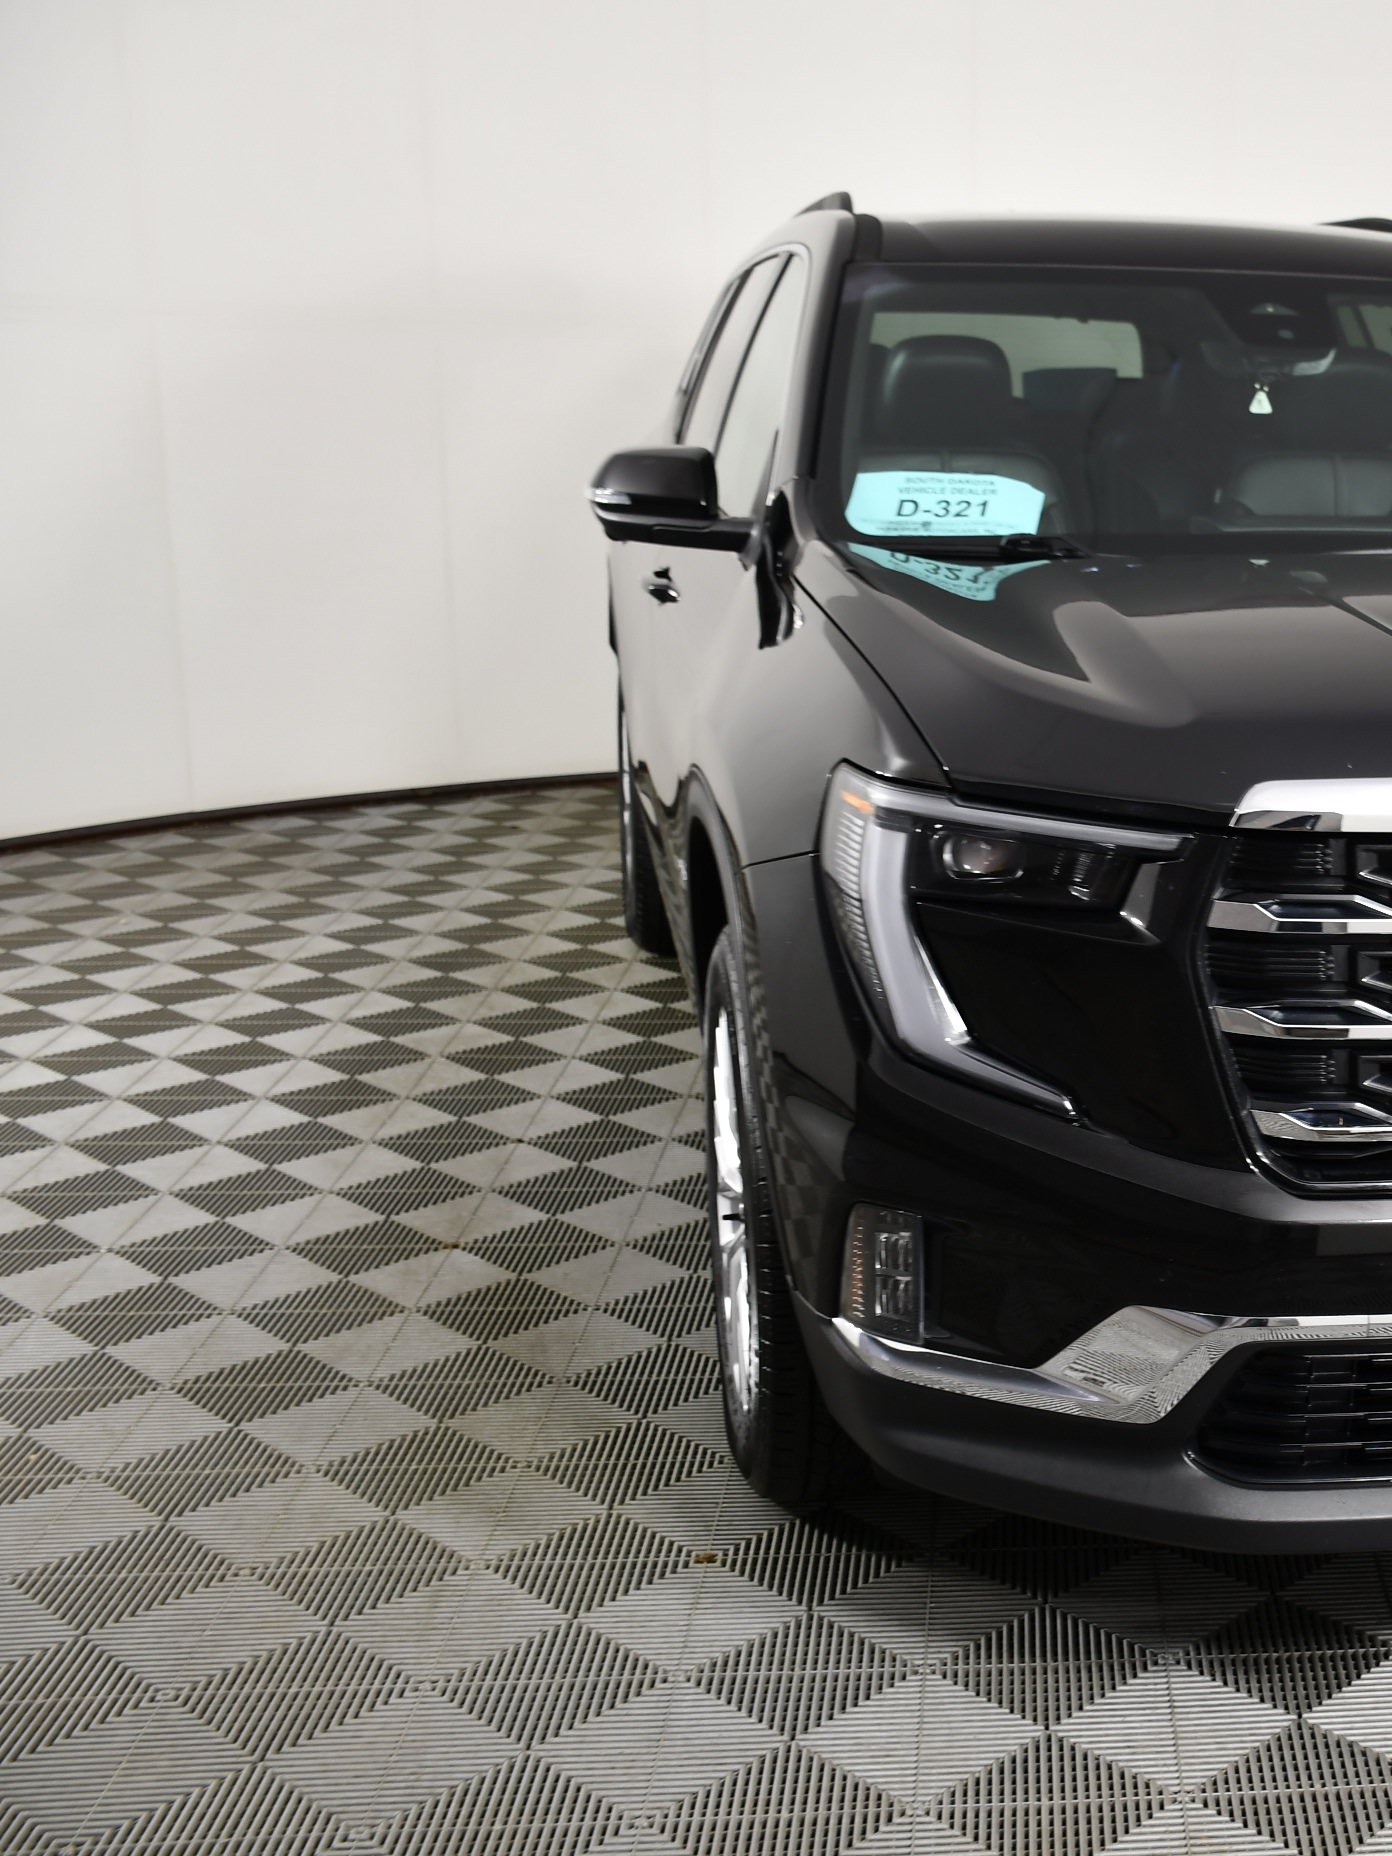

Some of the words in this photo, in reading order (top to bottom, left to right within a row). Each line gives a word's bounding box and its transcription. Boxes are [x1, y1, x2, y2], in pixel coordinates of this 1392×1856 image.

[897, 487, 946, 495] VEHICLE
[951, 487, 998, 496] DEALER
[896, 499, 989, 518] D-321
